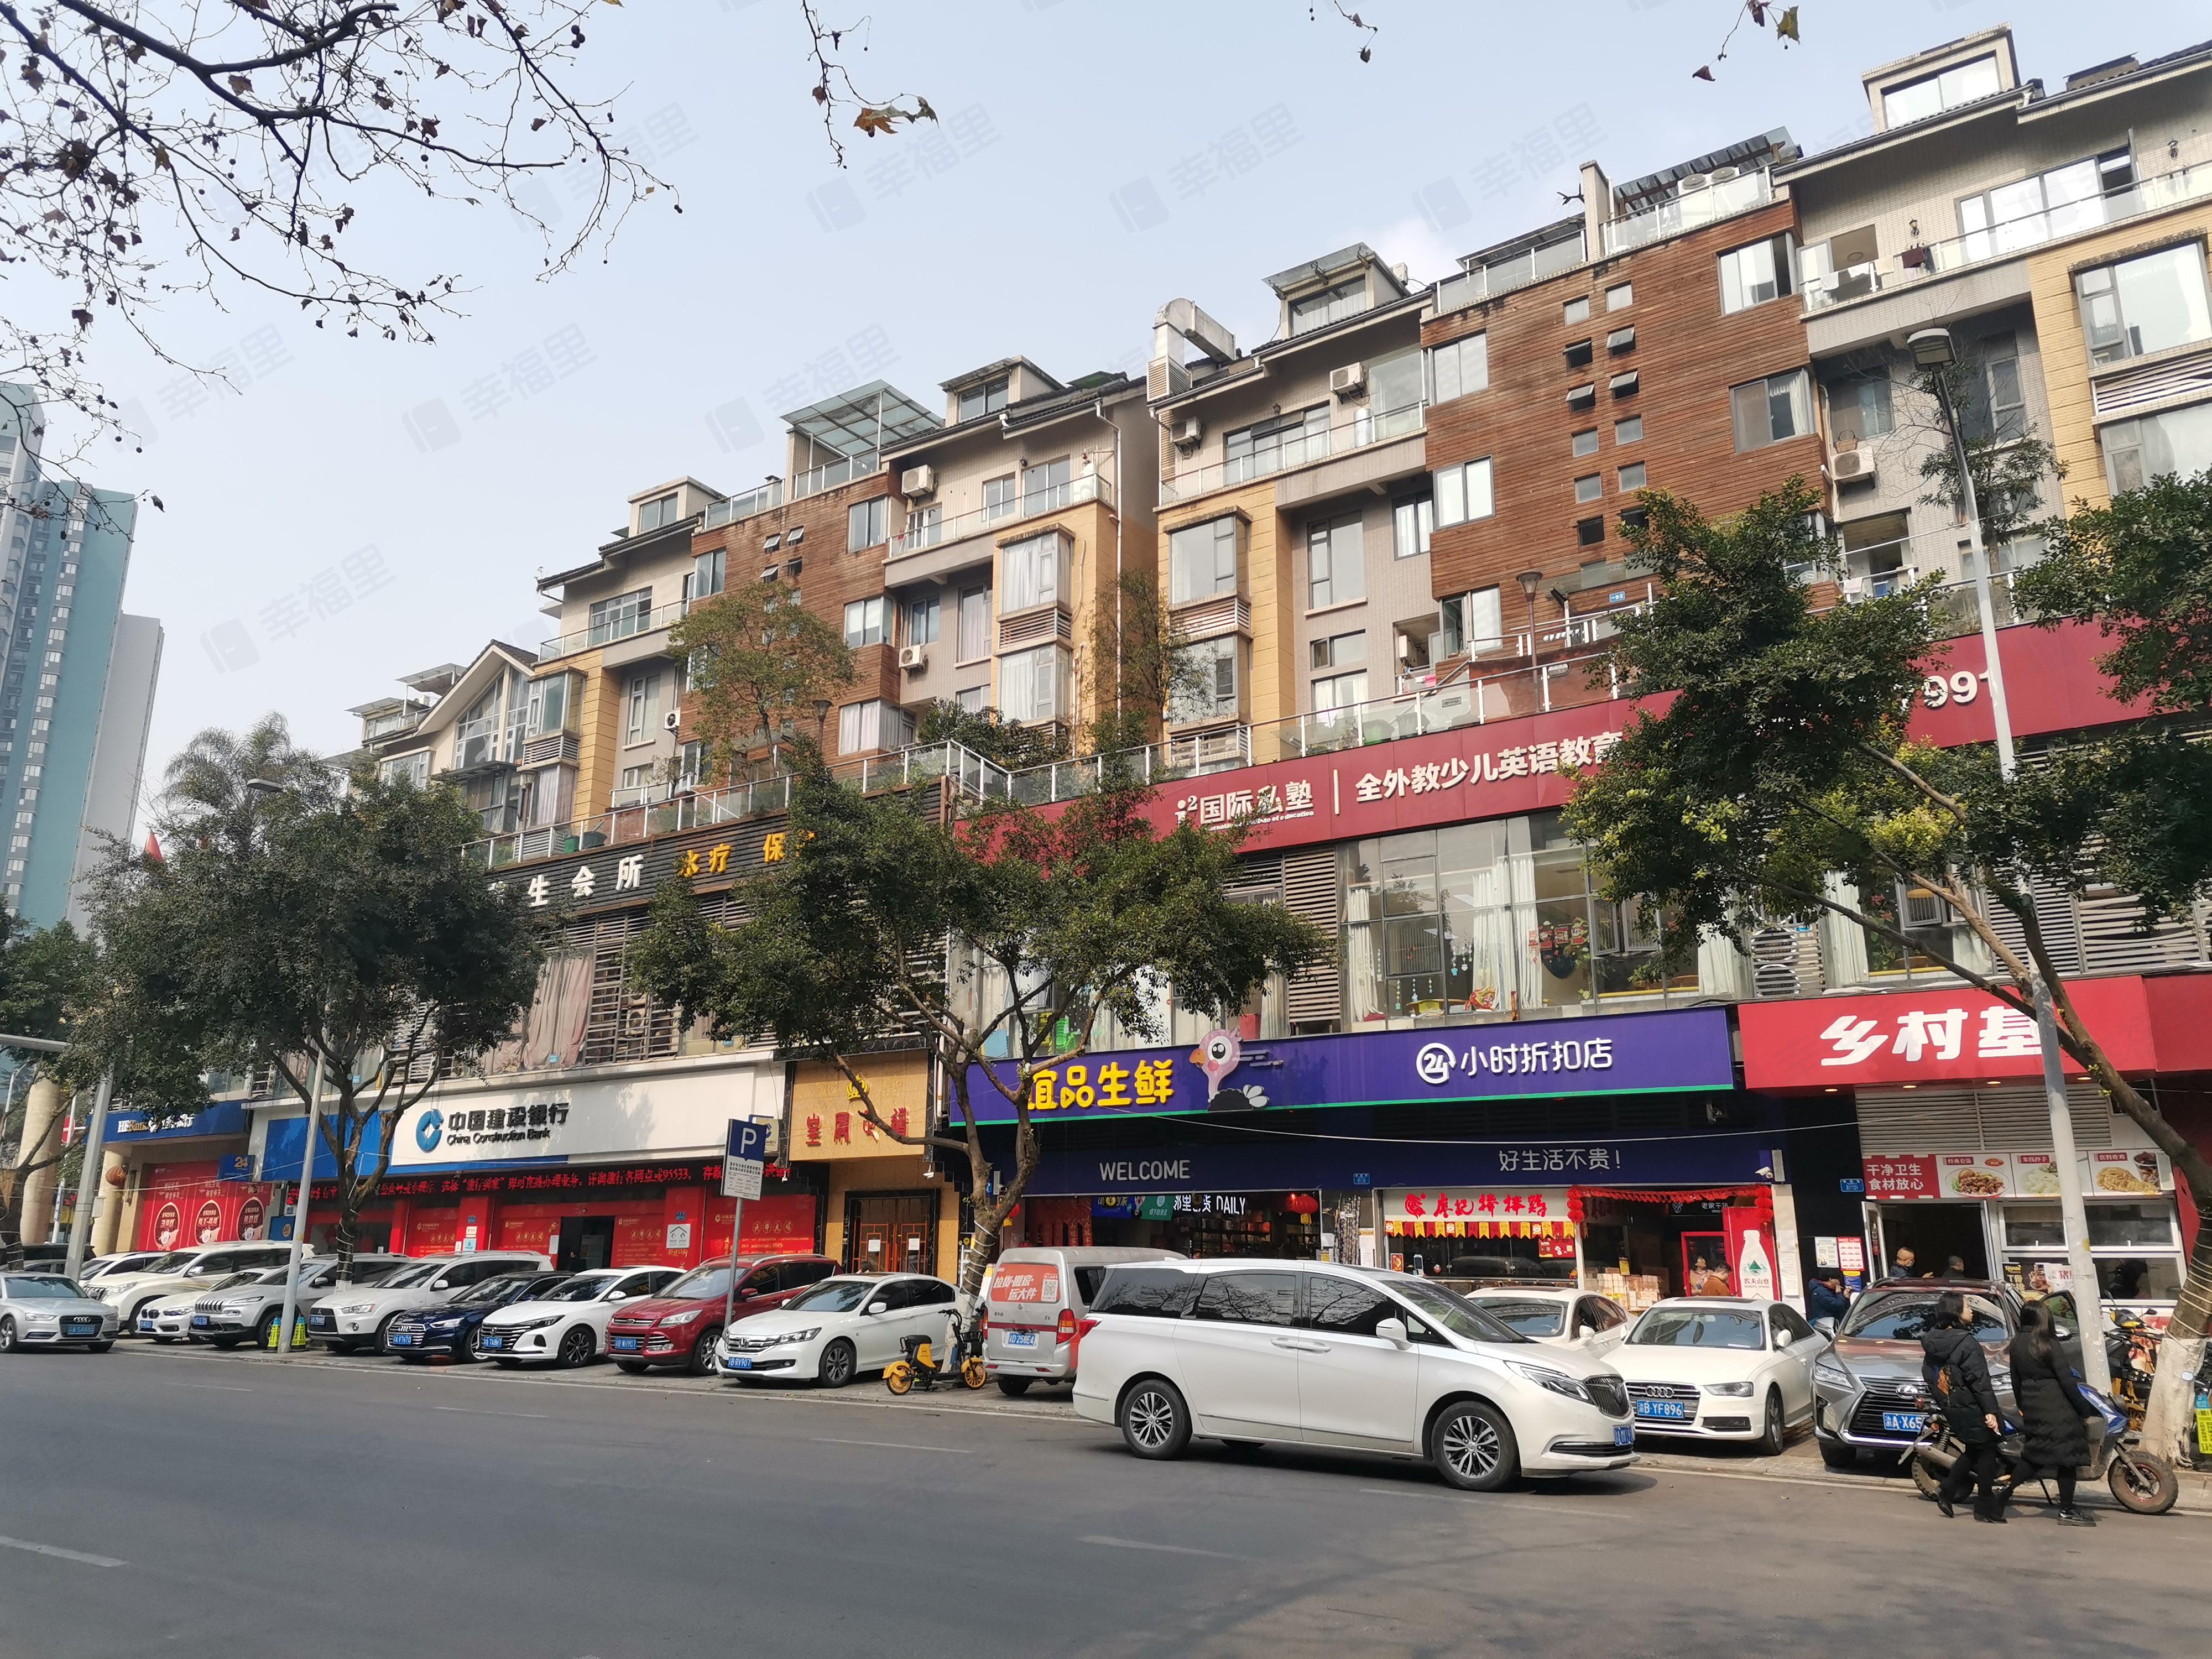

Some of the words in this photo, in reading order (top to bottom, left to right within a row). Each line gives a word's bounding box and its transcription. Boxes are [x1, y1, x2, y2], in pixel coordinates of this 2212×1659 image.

[1280, 810, 1314, 821] education
[499, 854, 644, 907] 生会所
[1819, 1005, 2042, 1066] 乡村基
[1028, 1058, 1174, 1110] 宜品生鲜
[448, 1102, 569, 1131] 中国建设银行
[447, 1134, 471, 1146] China
[473, 1130, 525, 1144] Construction
[527, 1128, 550, 1140] Bank
[740, 1128, 757, 1154] P
[1099, 1160, 1190, 1181] WELCOME
[1499, 1147, 1621, 1172] 好生活不贵！
[1866, 1164, 1923, 1176] 干净卫生
[1868, 1178, 1924, 1191] 食材放心
[1217, 1195, 1245, 1215] DAILY
